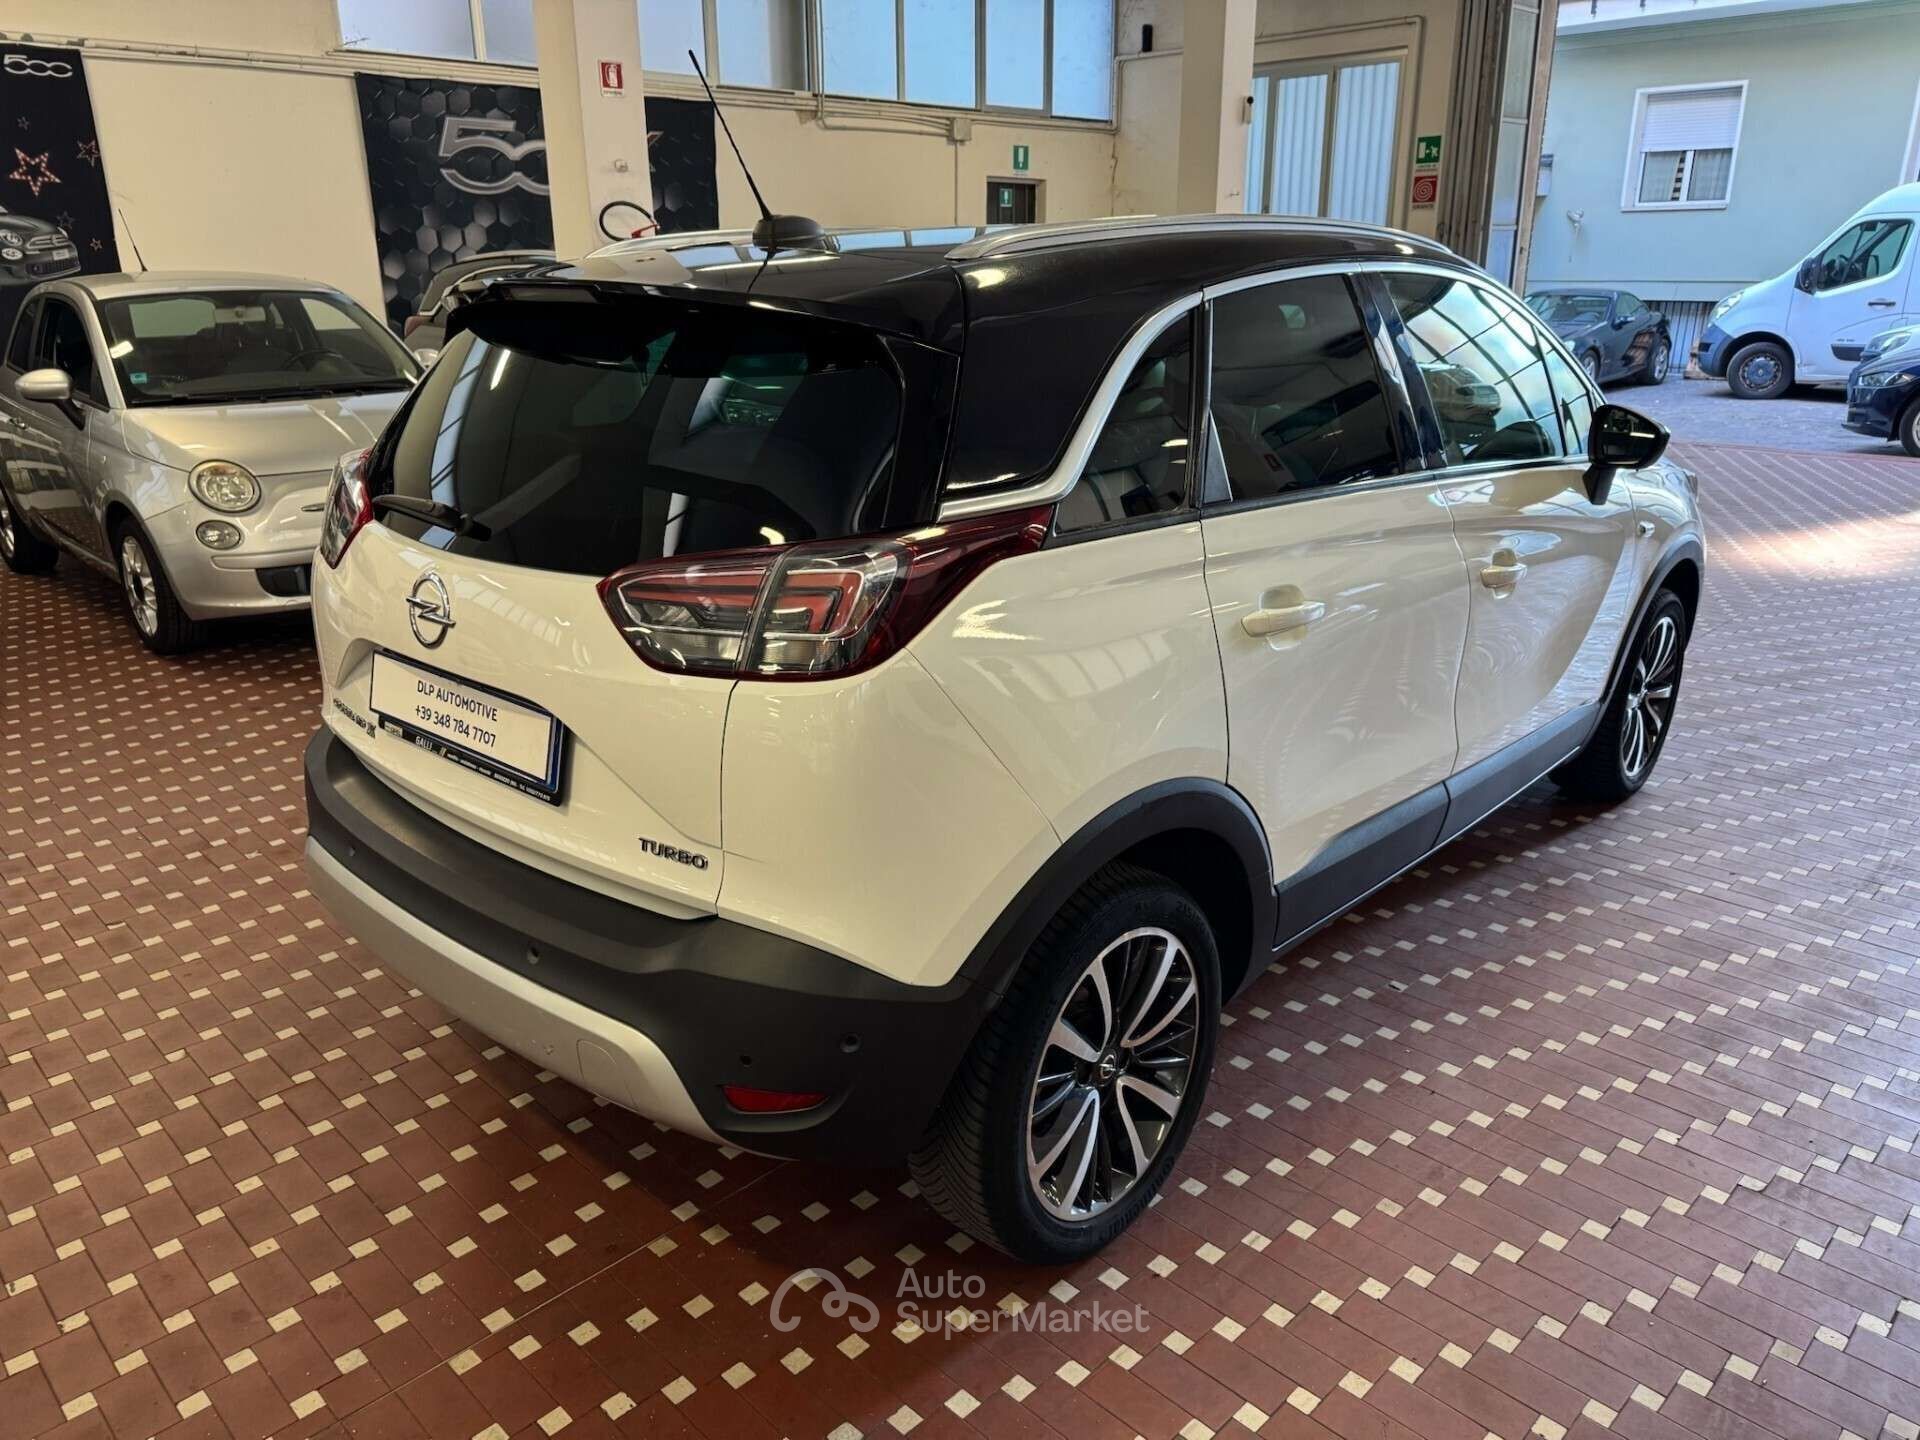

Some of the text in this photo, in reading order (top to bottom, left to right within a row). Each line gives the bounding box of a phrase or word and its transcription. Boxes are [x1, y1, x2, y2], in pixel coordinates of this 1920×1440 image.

[3, 54, 73, 78] 500
[417, 680, 498, 722] DLP AUTOMOTIVE
[415, 705, 496, 747] +39 348 784 7707
[638, 838, 709, 870] TURBO
